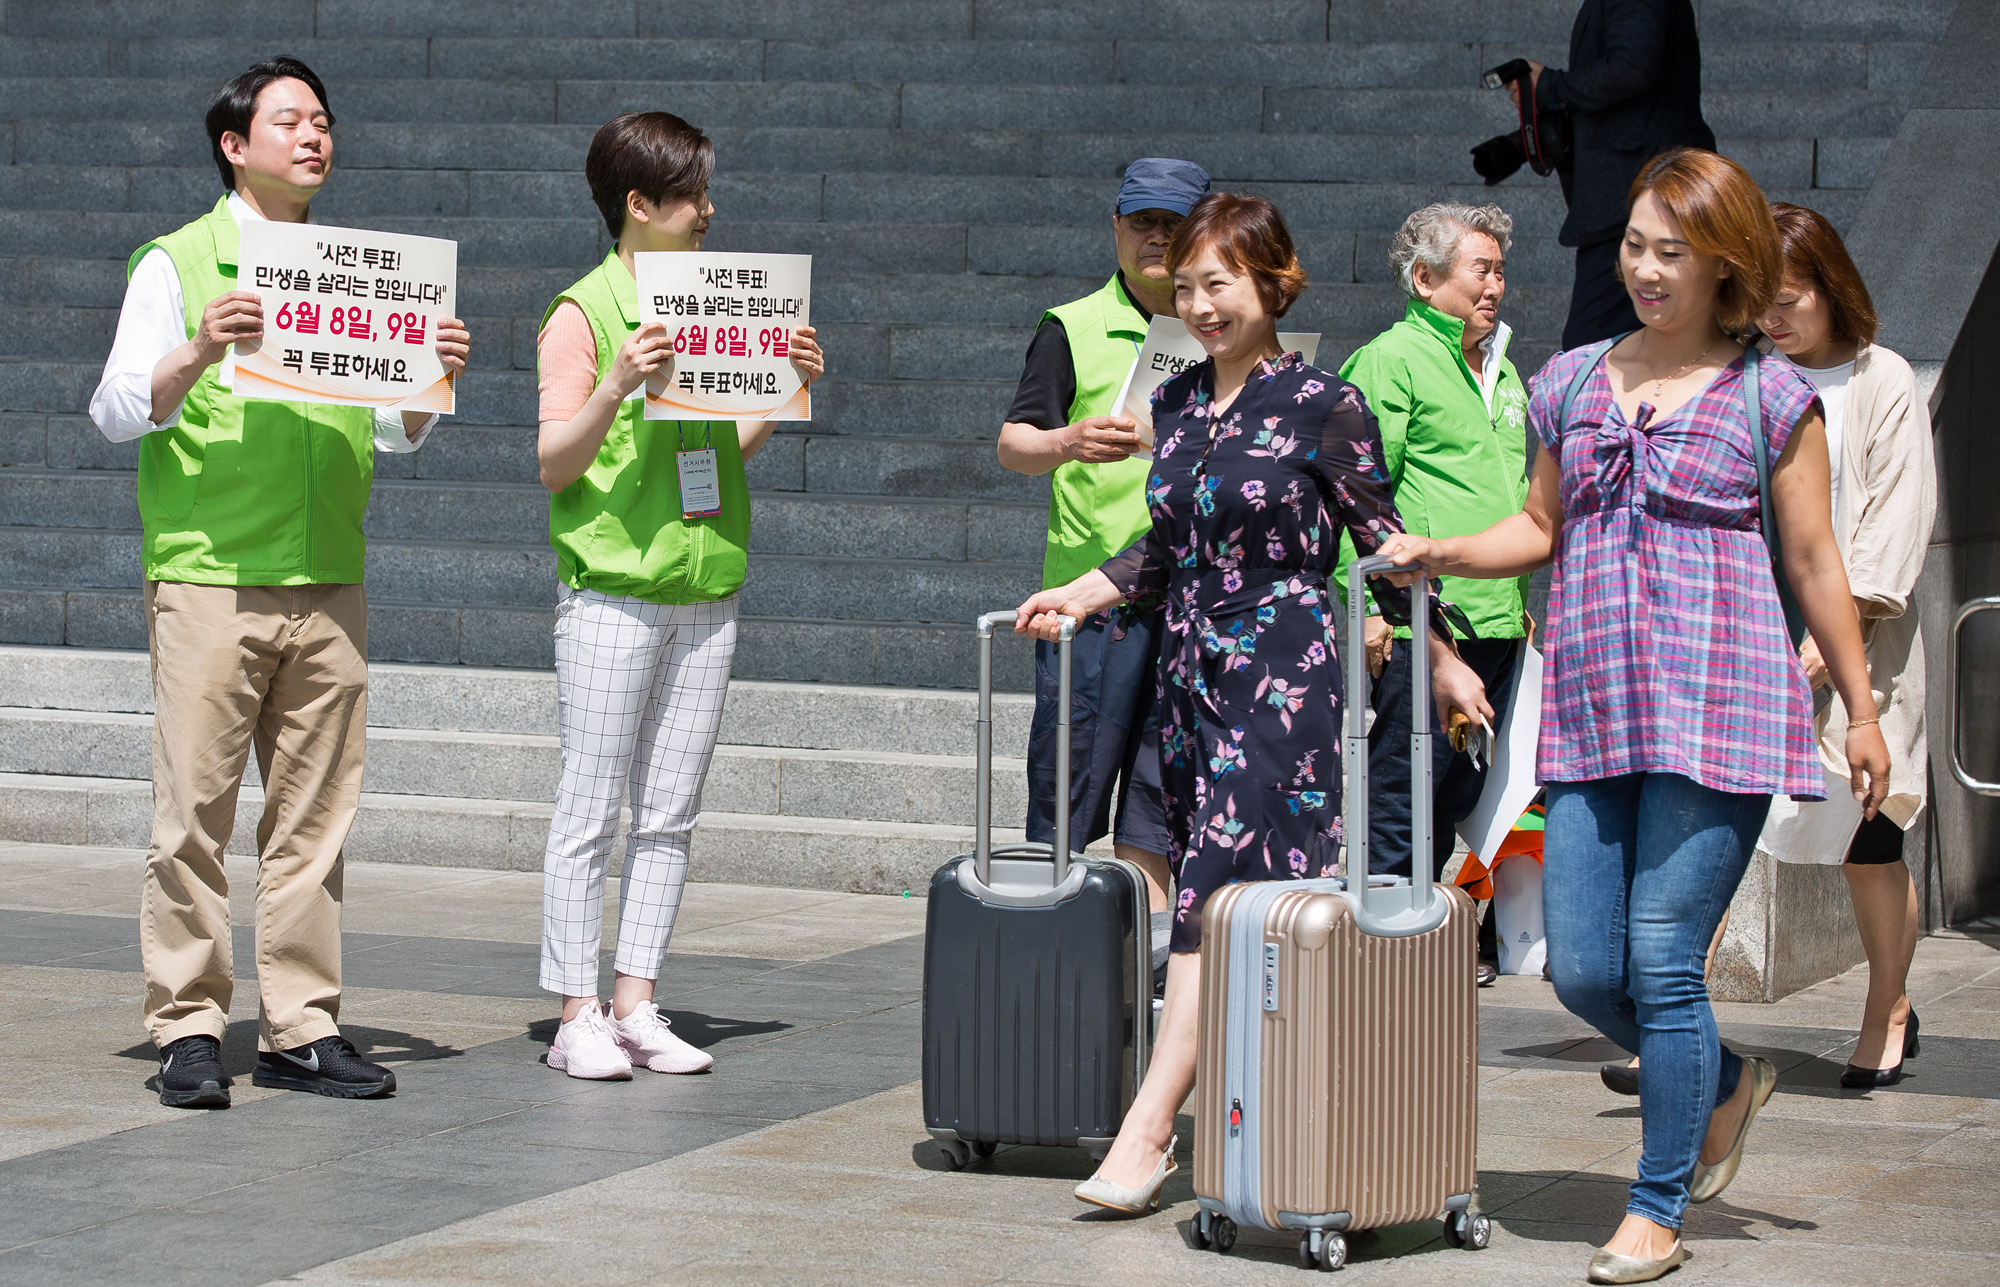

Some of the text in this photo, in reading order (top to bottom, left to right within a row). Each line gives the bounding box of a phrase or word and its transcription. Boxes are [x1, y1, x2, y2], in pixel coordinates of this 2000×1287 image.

[317, 242, 402, 271] "사전 투표!
[255, 266, 447, 305] 민생을 살리는 힘입니다!"
[699, 267, 768, 289] "사전 투표!
[653, 294, 804, 318] 민생을 살리는 힘입니다!"
[276, 301, 427, 345] 6월 8일, 9일
[674, 325, 790, 358] 6월 8일, 9일
[282, 348, 414, 383] 꼭 투표하세요.
[679, 371, 782, 396] 꼭 투표하세요.
